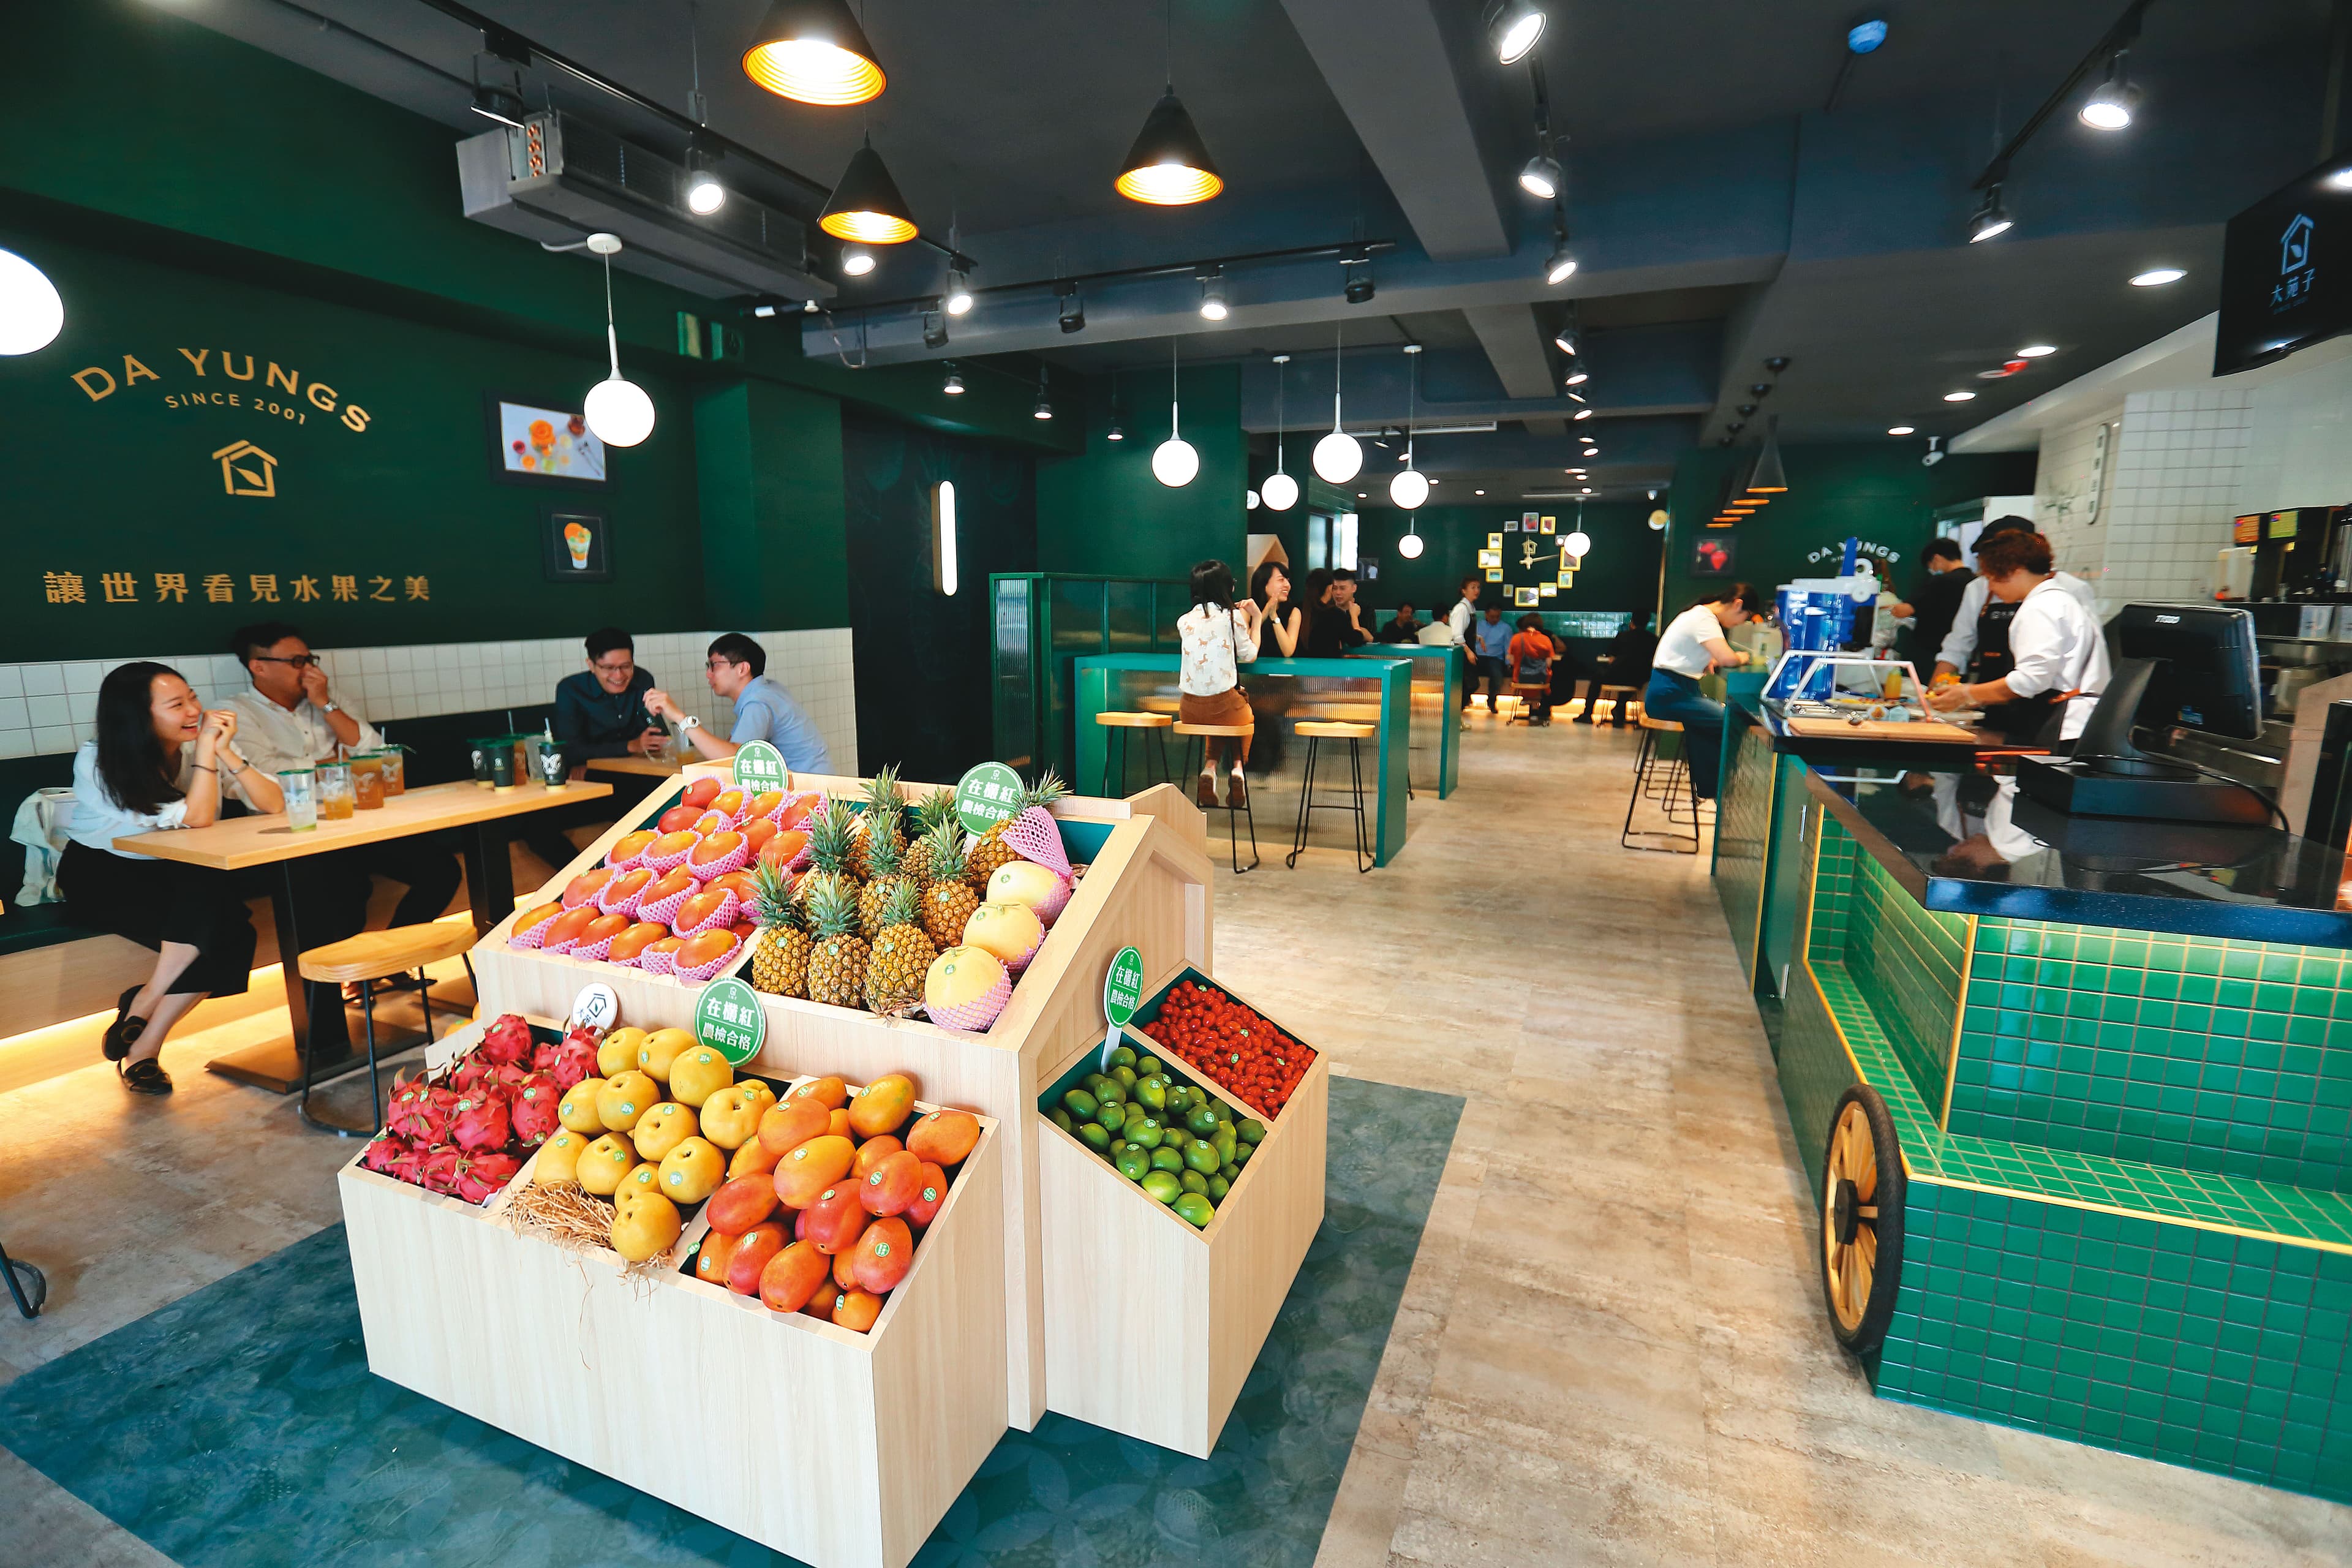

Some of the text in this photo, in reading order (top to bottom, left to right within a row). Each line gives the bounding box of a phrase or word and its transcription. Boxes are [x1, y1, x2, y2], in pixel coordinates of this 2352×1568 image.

[70, 348, 371, 432] DA YUNGS
[165, 392, 306, 425] SINCE 2001
[1807, 546, 1833, 564] DA
[43, 571, 430, 604] 讓世界看見水果之美
[702, 1021, 752, 1052] 農檢合格
